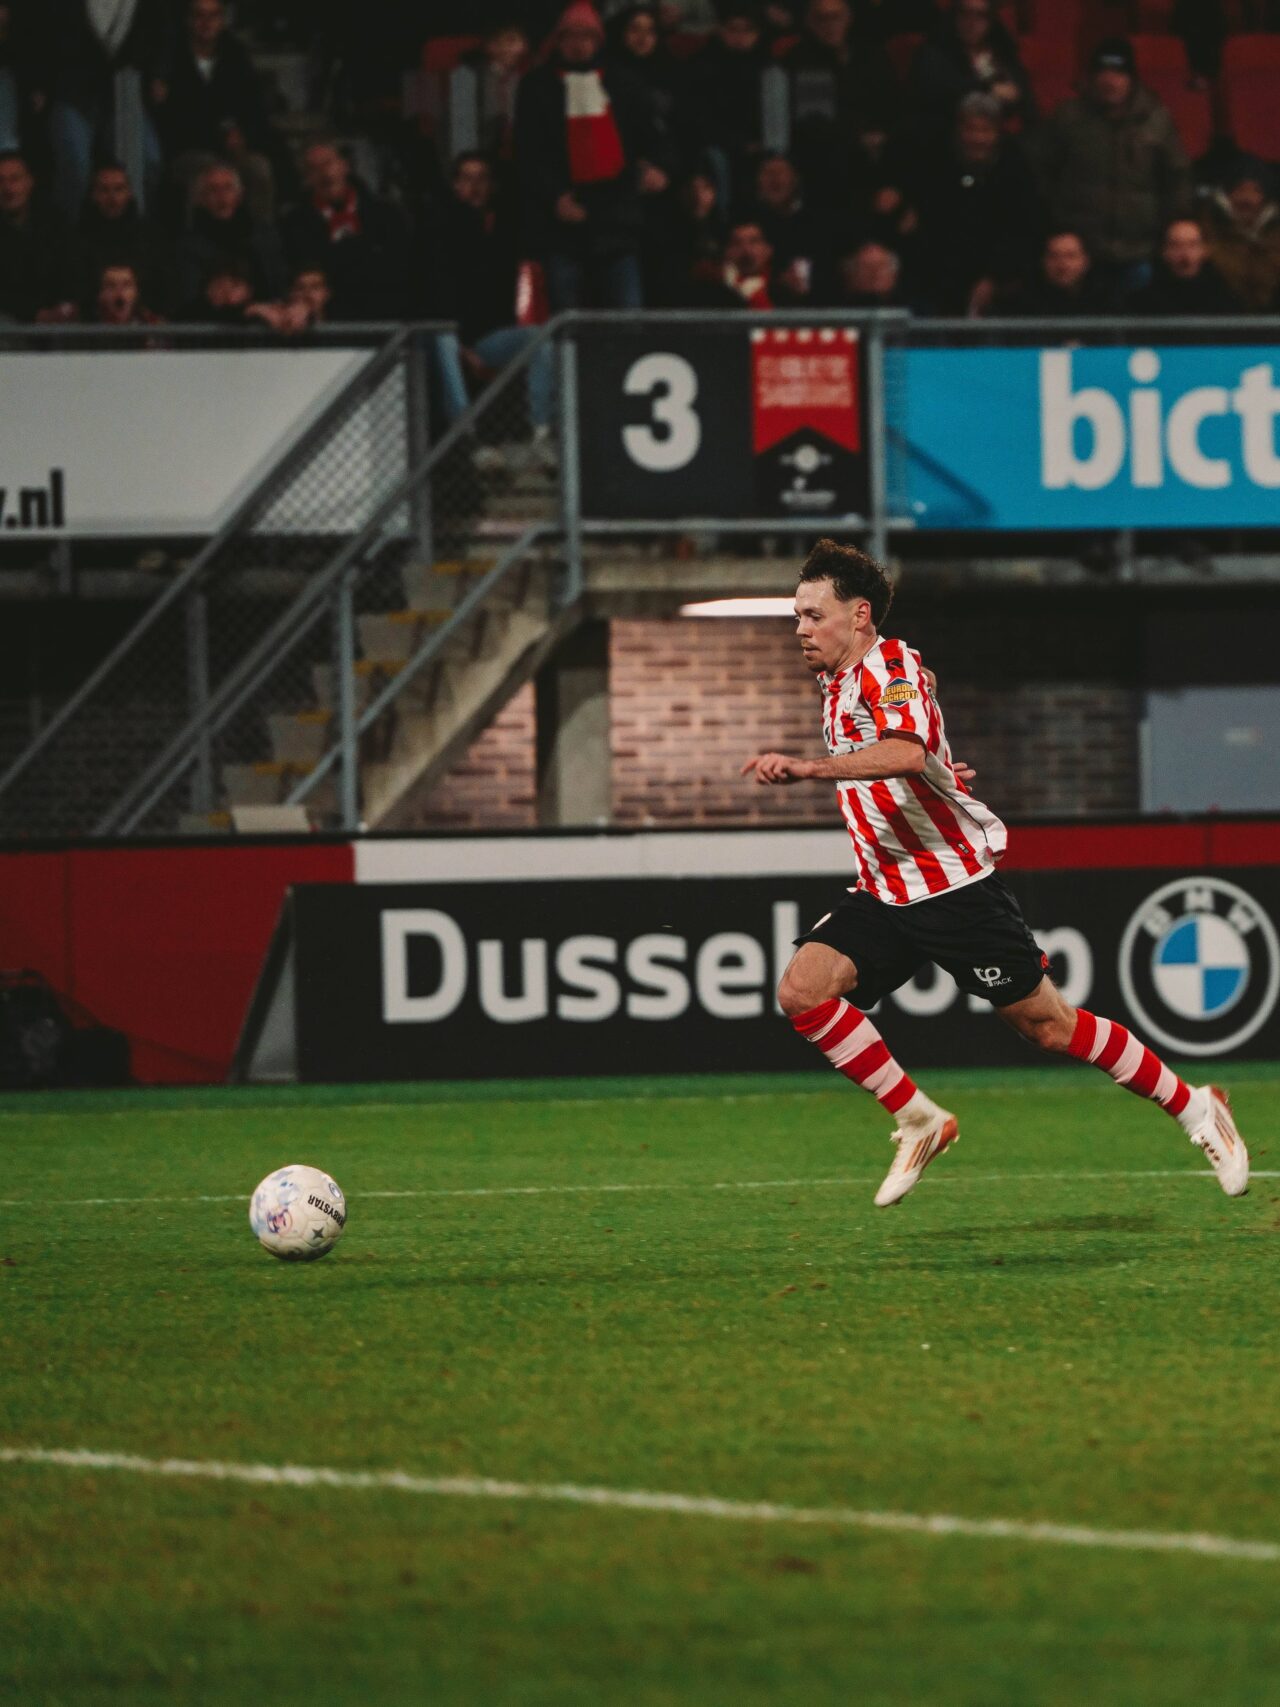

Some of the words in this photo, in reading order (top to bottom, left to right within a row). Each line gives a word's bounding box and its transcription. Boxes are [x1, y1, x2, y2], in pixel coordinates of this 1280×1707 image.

[623, 351, 701, 473] 3
[886, 683, 910, 695] EURO
[1142, 888, 1258, 938] BMW
[381, 901, 1093, 1023] Dusselp
